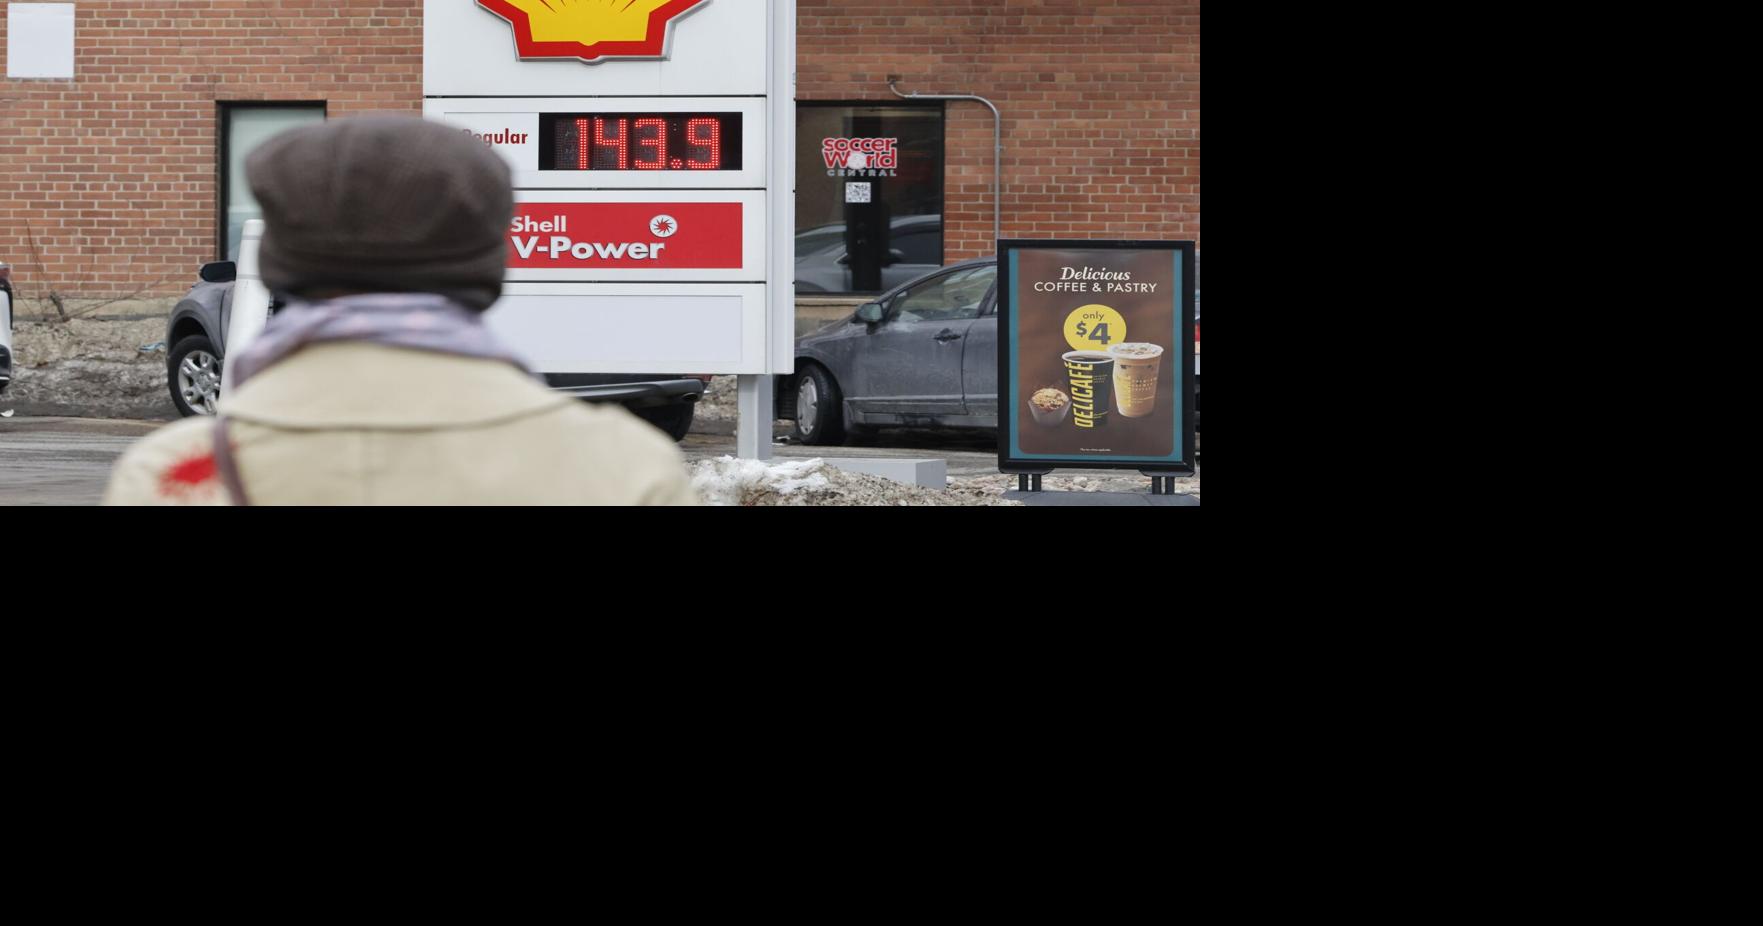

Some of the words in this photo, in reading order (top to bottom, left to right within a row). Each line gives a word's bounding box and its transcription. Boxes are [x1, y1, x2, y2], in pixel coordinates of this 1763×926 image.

[576, 118, 720, 169] 143.9
[822, 137, 898, 152] soccer
[826, 169, 897, 177] CENTRAL
[511, 216, 566, 232] Shell
[511, 236, 665, 260] V-Power
[1059, 266, 1131, 281] Delicious
[1034, 281, 1087, 293] COFFEE
[1092, 282, 1102, 293] &
[1107, 282, 1158, 293] PASTRY
[1082, 311, 1105, 321] only
[1076, 320, 1112, 345] $4
[1064, 360, 1094, 428] DELICAFÉ
